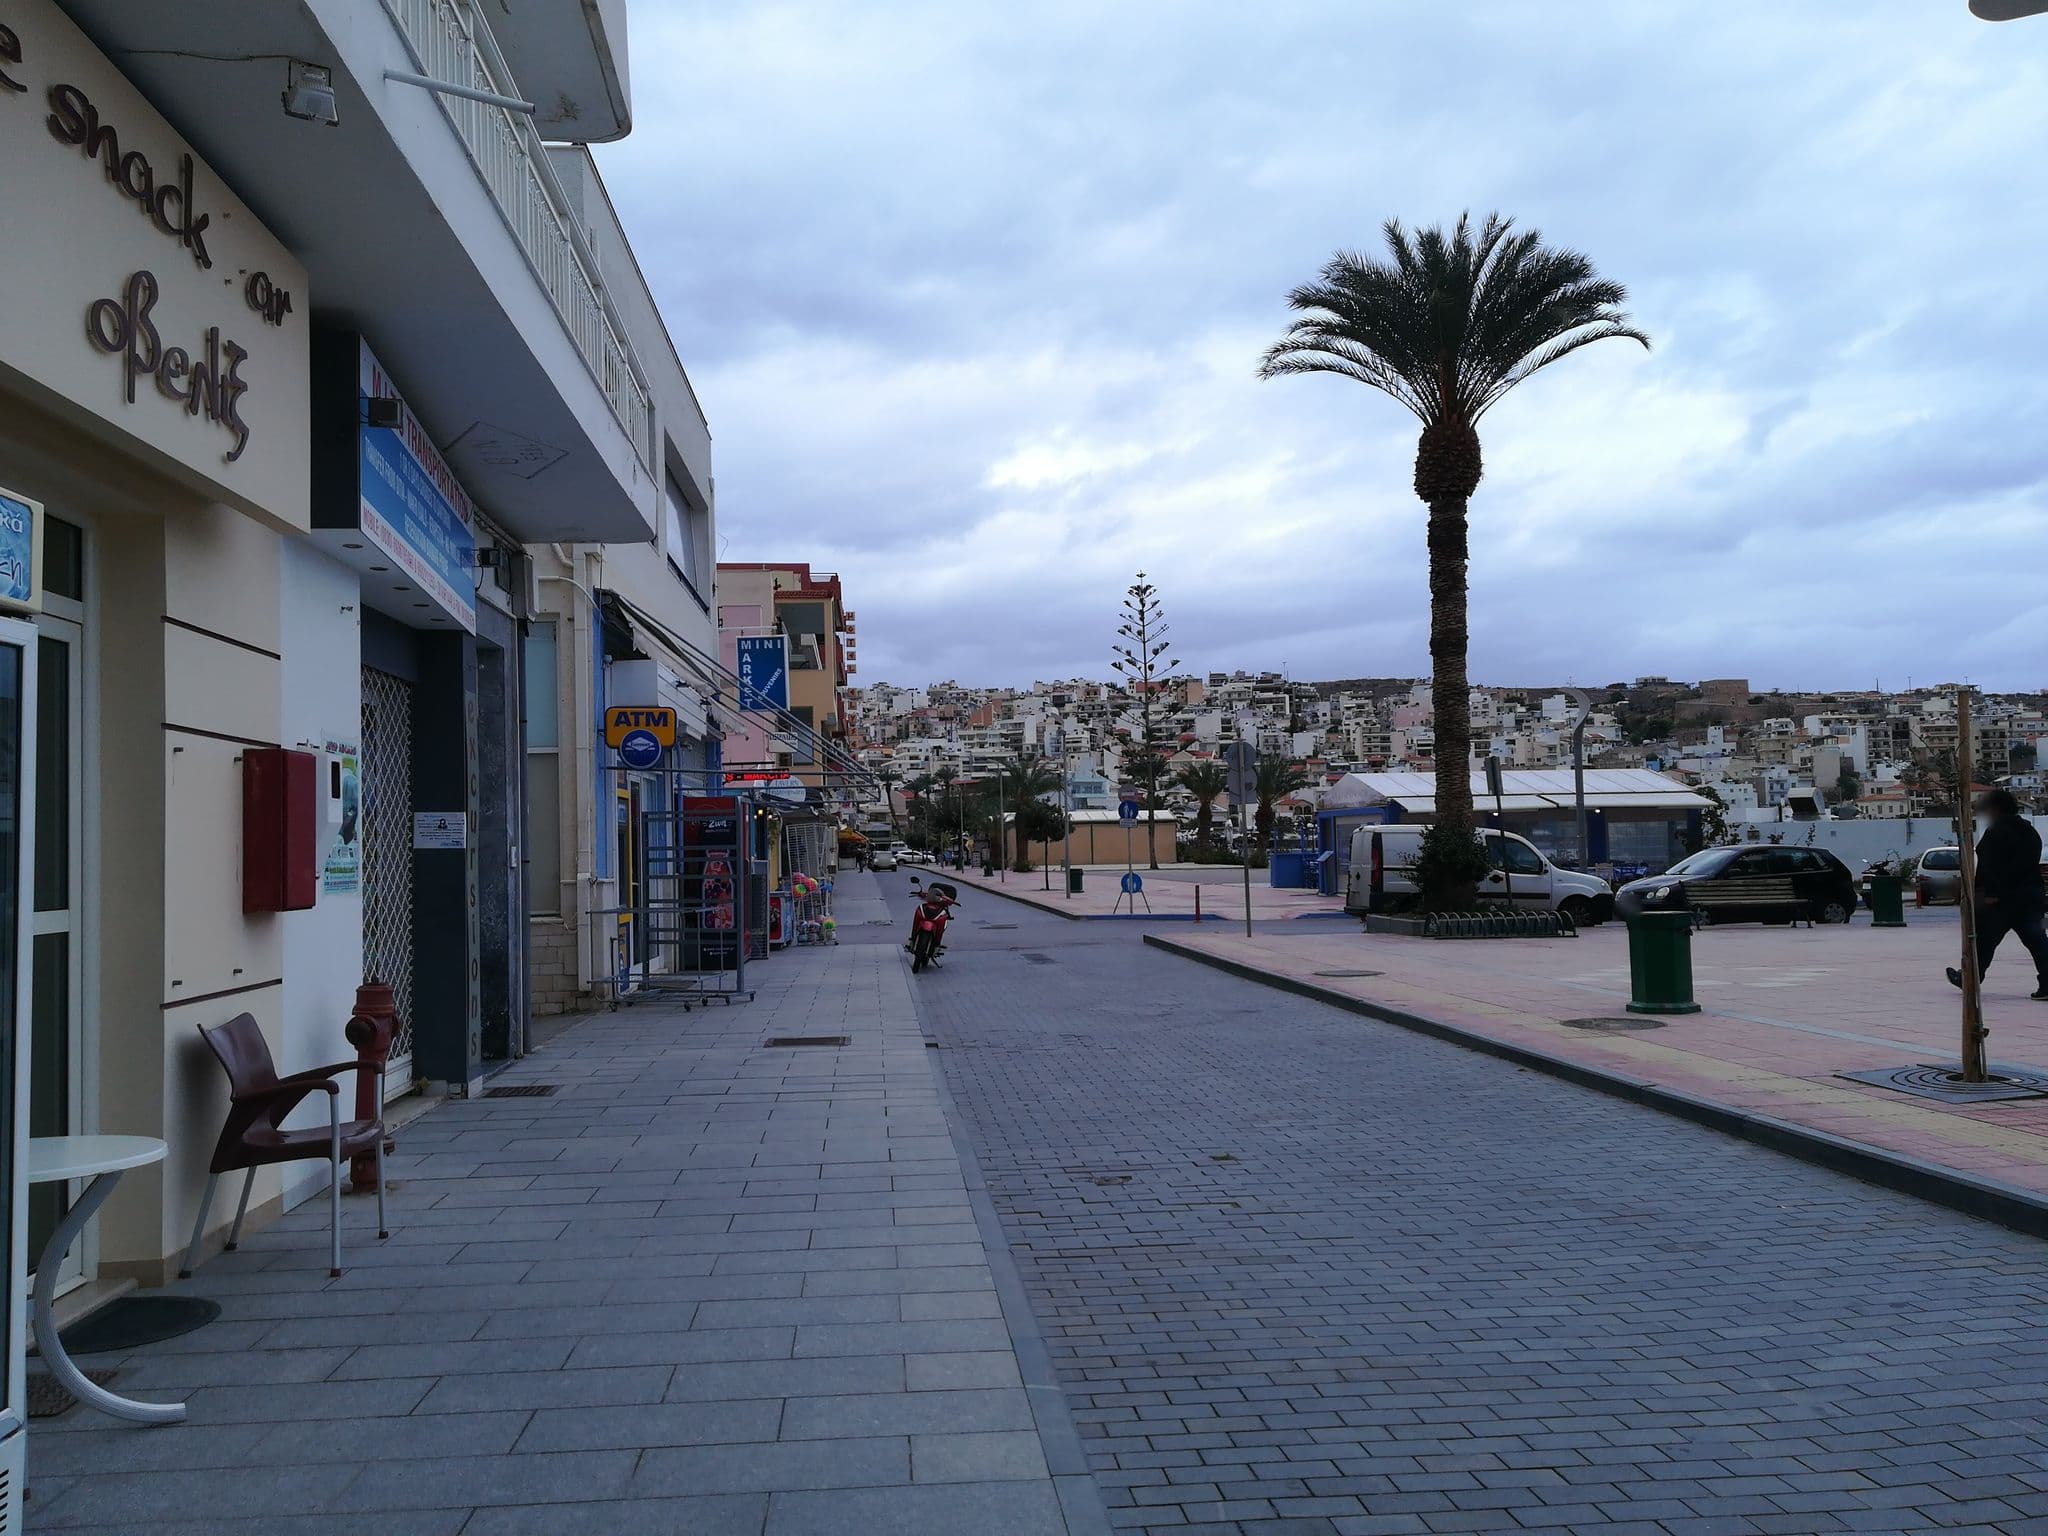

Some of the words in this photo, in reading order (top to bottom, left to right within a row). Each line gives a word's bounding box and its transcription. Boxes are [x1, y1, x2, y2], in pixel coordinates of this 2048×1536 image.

[49, 83, 213, 270] snack
[741, 639, 781, 650] MINI
[614, 711, 669, 727] ATM
[467, 700, 478, 1057] excursions
